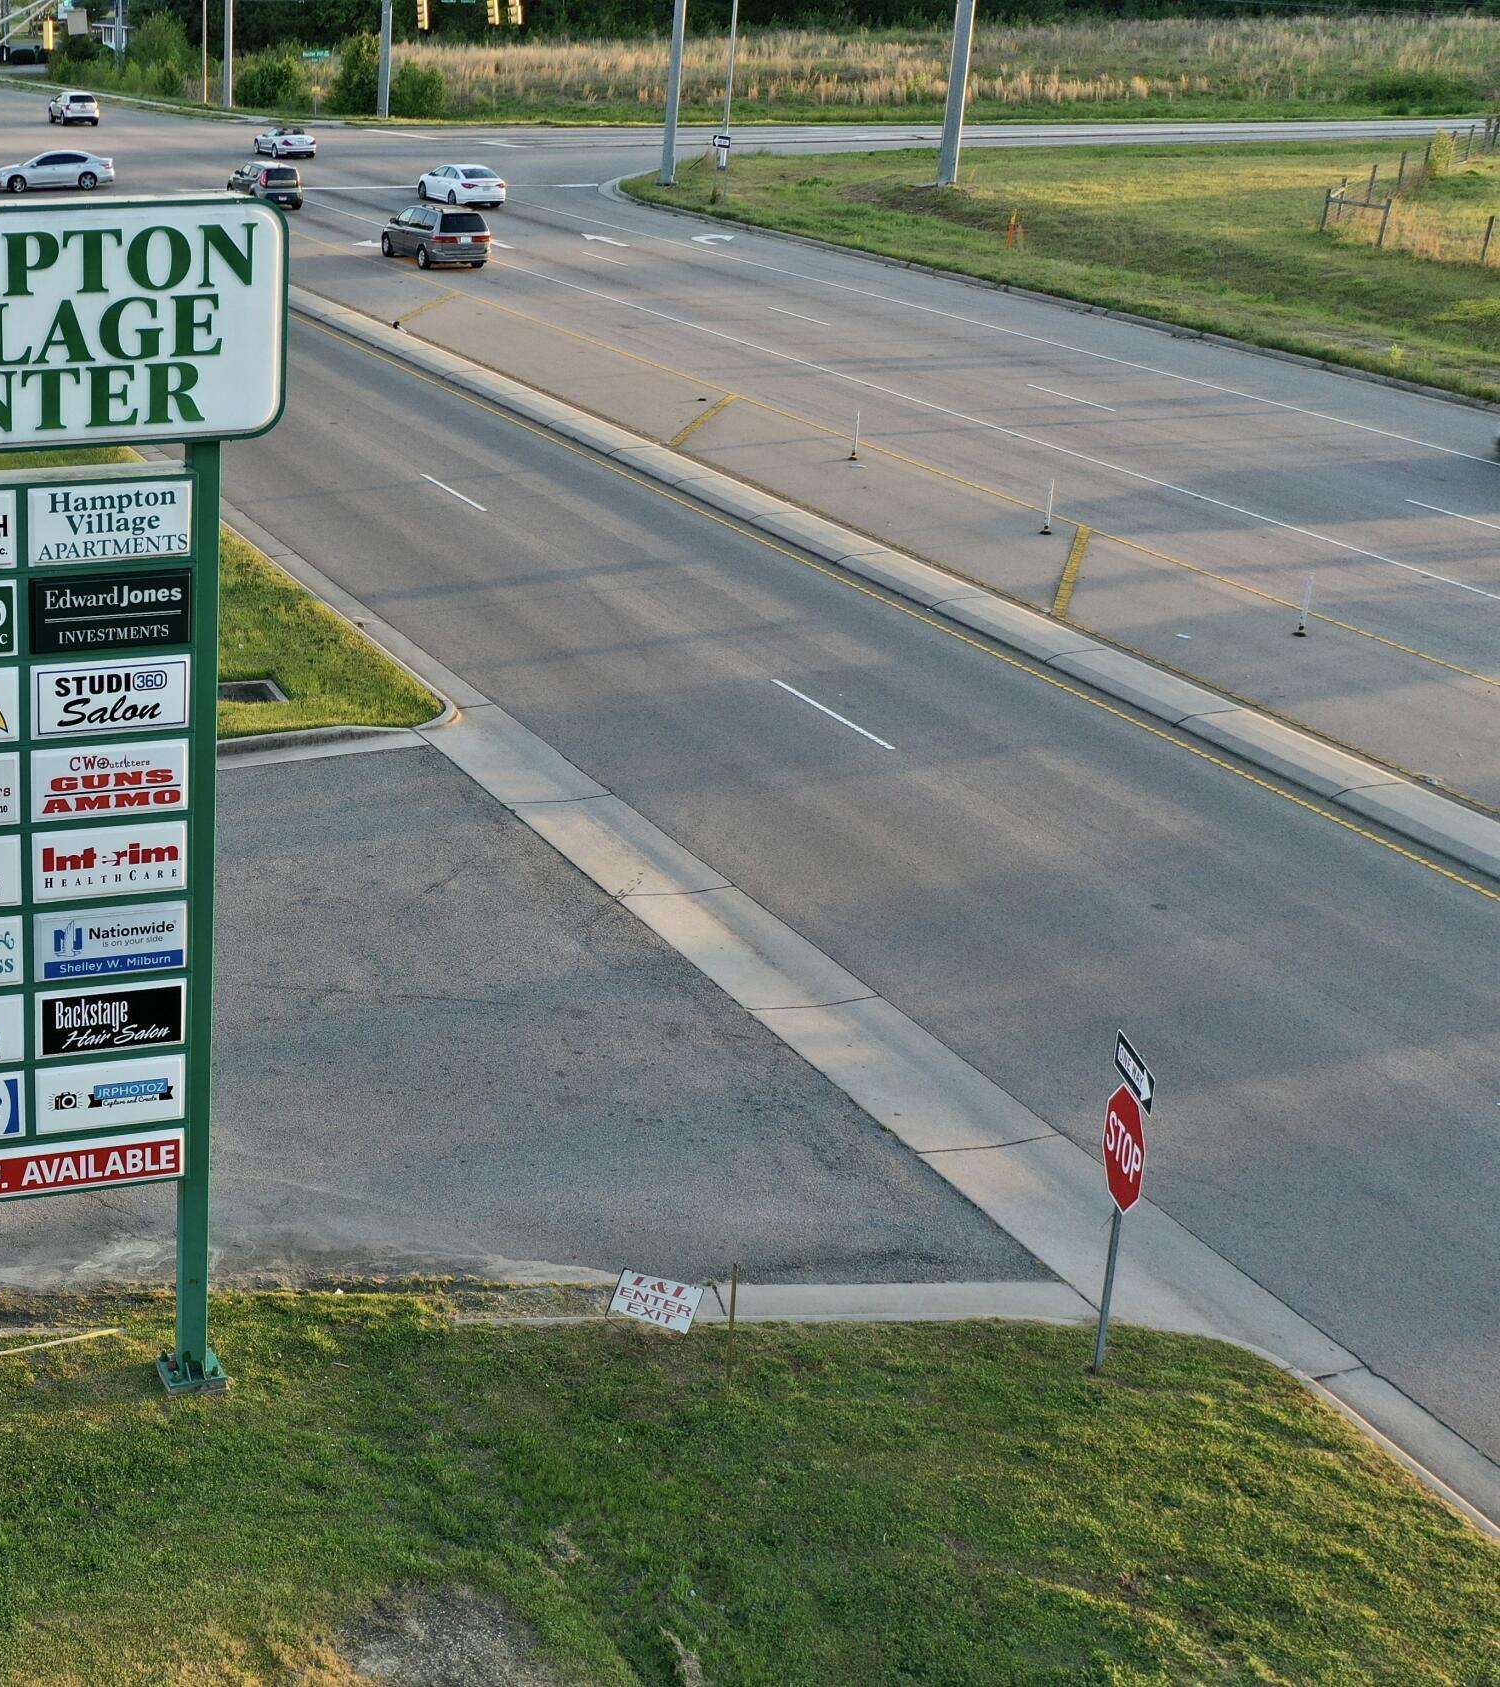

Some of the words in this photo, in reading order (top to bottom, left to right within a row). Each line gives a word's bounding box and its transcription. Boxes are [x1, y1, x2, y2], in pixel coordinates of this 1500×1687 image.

[48, 489, 177, 514] Hampton
[65, 512, 161, 536] Village
[38, 533, 188, 561] APARTMENTS
[58, 624, 170, 645] INVESTMENTS
[57, 694, 162, 727] Salon
[50, 769, 174, 792] GUNS
[42, 789, 181, 814] AMMO
[88, 921, 175, 940] Nationwide
[102, 940, 109, 948] is
[124, 938, 144, 947] your
[146, 935, 163, 943] side
[59, 960, 102, 974] Shelley
[106, 959, 123, 969] W.
[126, 955, 171, 967] Milburn
[55, 999, 128, 1033] Backstage
[62, 1029, 111, 1049] Hair
[113, 1024, 170, 1044] Salon
[1118, 1045, 1133, 1074] ONE
[1131, 1061, 1144, 1088] WAY
[96, 1082, 165, 1098] JRPHOTOZ
[1106, 1110, 1141, 1183] STOP
[21, 1144, 176, 1187] AVAILABLE
[619, 1286, 692, 1317] ENTER
[626, 1301, 677, 1324] EXIT
